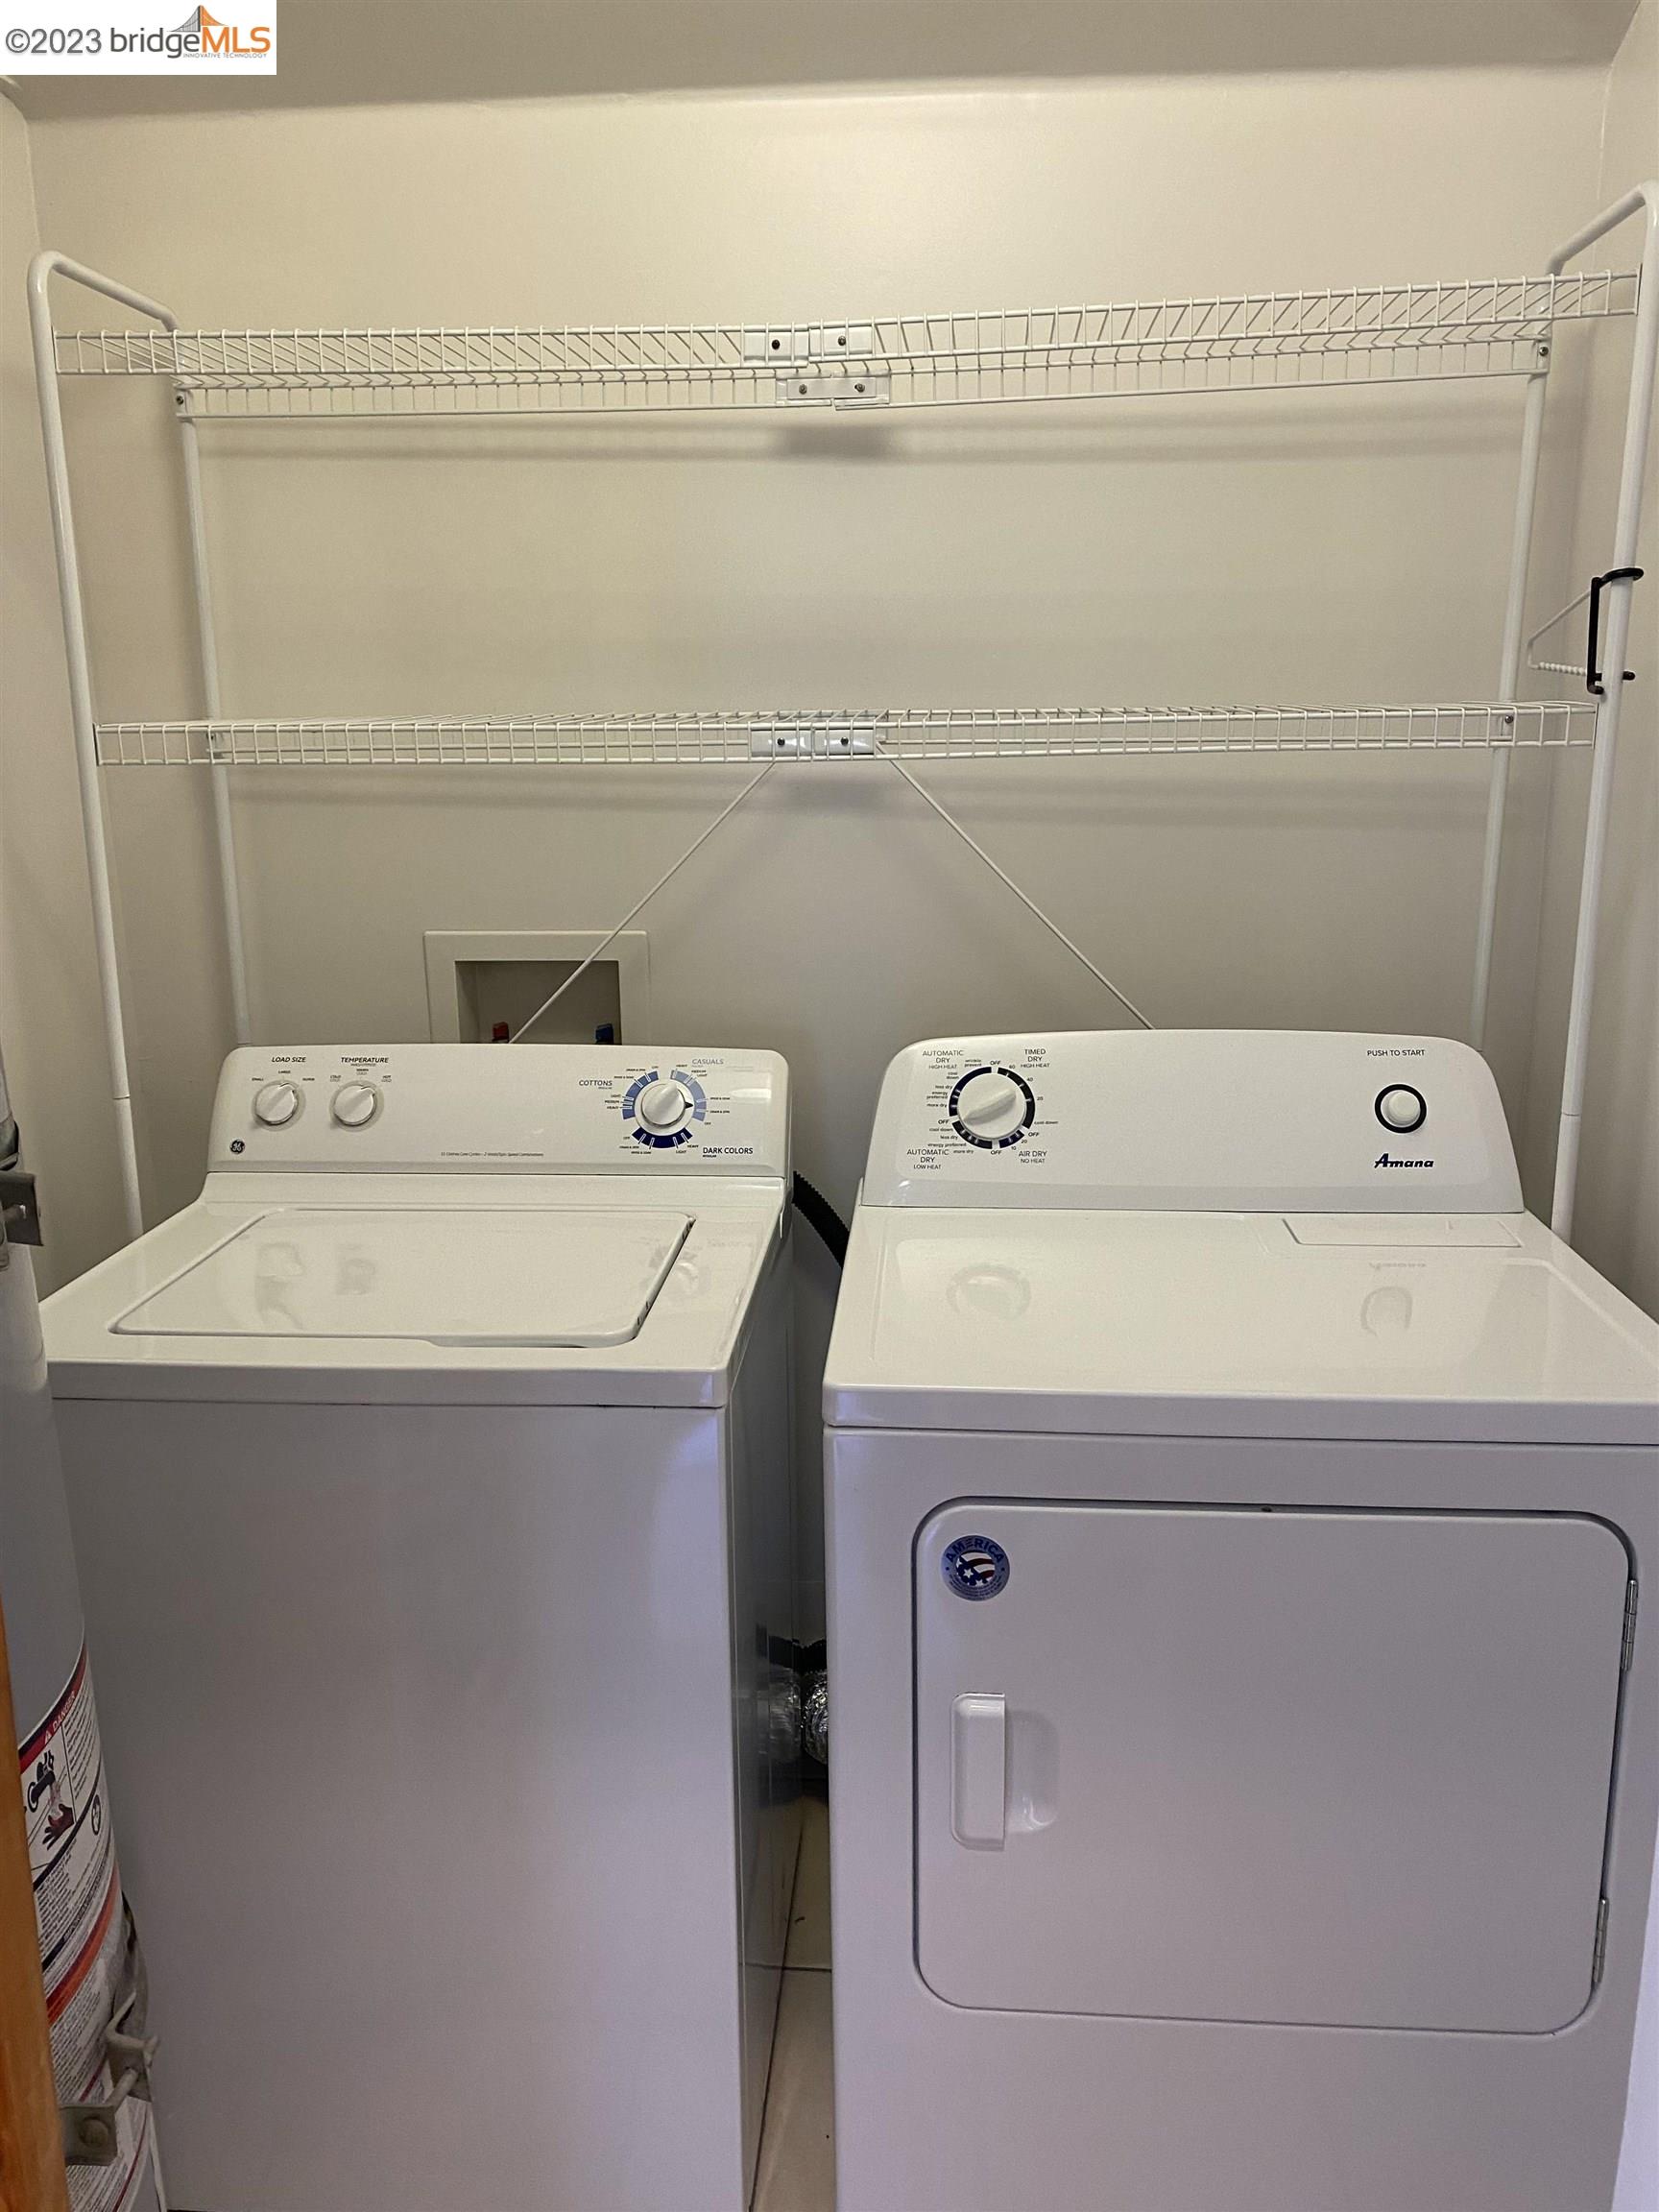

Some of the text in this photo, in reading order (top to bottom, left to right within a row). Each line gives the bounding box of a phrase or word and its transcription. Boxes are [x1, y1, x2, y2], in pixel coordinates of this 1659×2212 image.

[702, 1146, 755, 1155] DARK COLORS
[1374, 1152, 1434, 1168] Amana
[946, 1538, 1005, 1563] AMERICA
